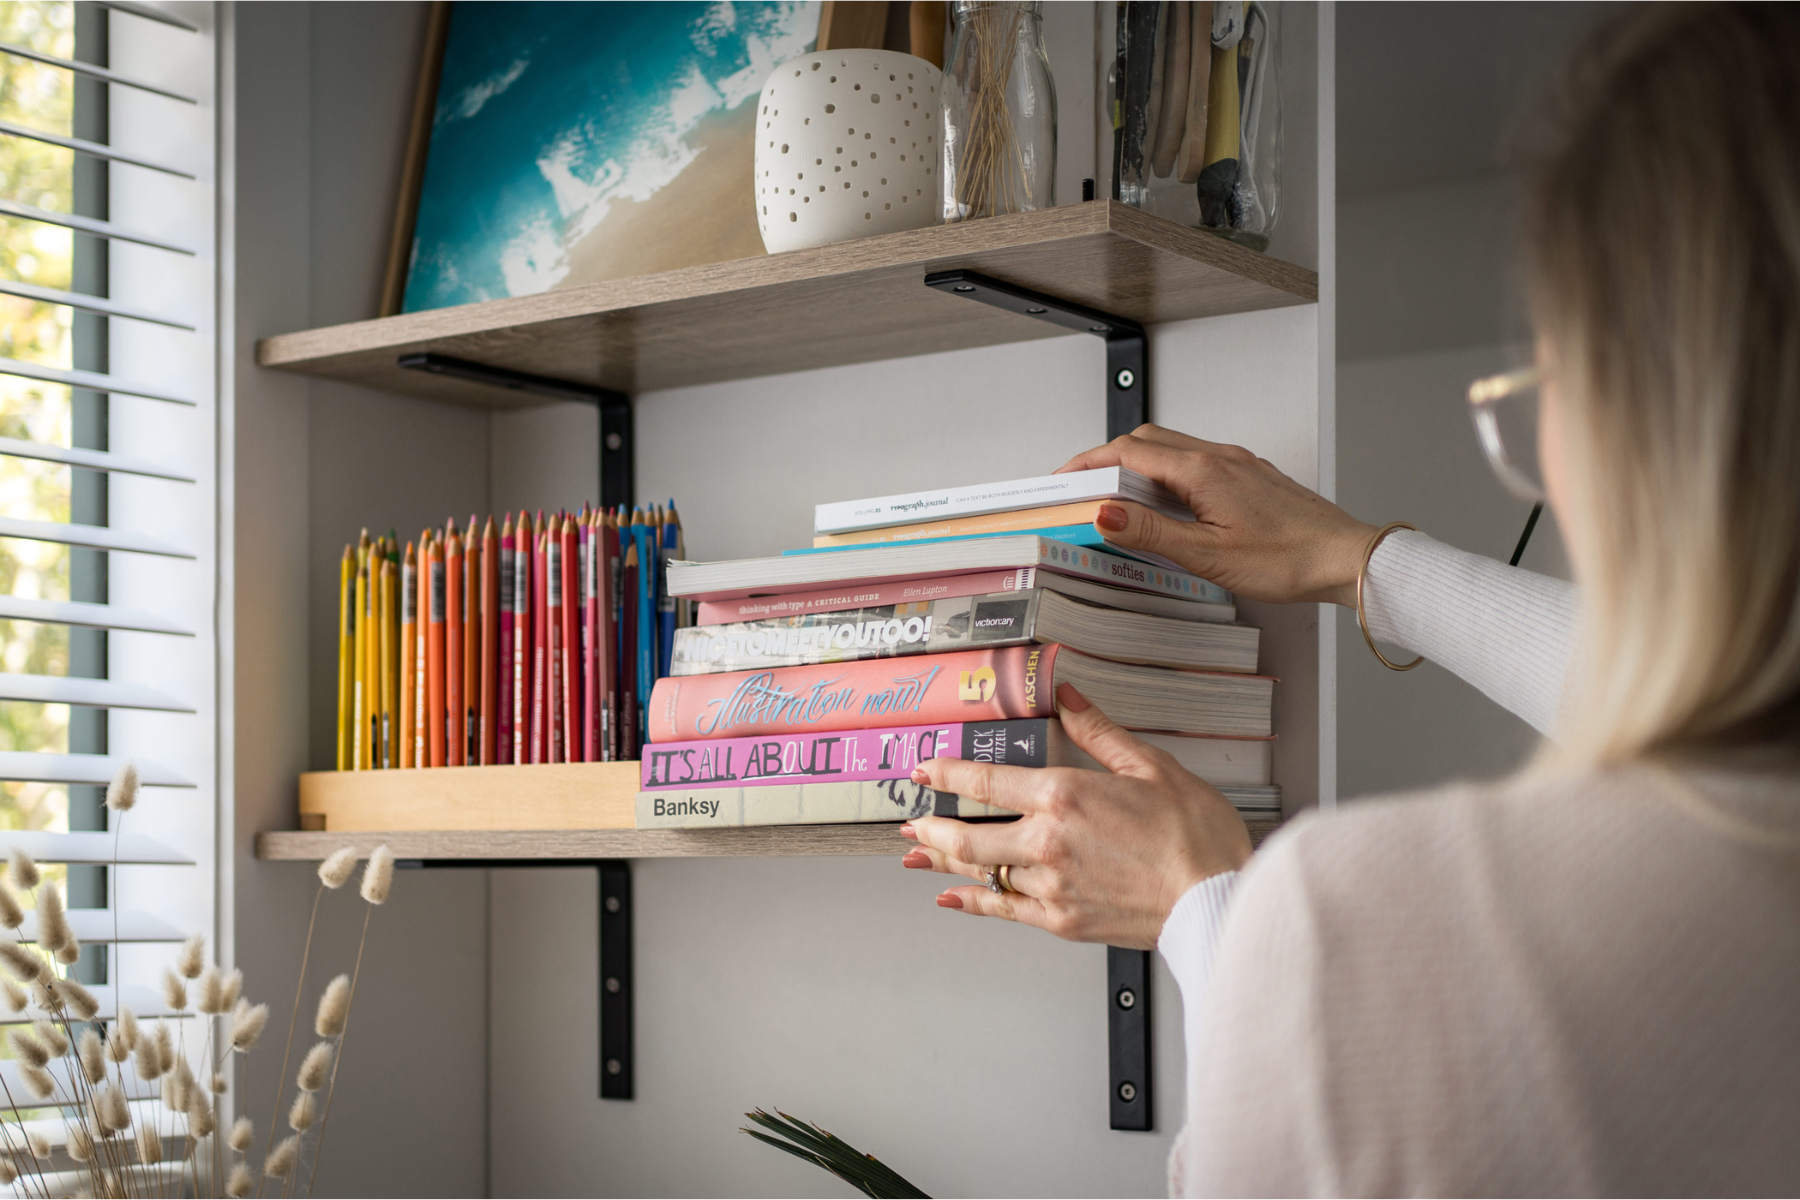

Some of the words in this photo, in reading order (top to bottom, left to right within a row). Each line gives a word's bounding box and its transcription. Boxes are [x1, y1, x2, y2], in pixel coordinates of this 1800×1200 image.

[1111, 562, 1145, 583] softies
[738, 603, 771, 615] thinking
[771, 600, 788, 611] with
[788, 599, 805, 611] type
[806, 599, 813, 607] A
[814, 596, 852, 607] CRITICAL
[853, 592, 880, 602] GUIDE
[903, 587, 921, 598] Ellen
[922, 585, 948, 597] Lupton
[958, 666, 997, 703] 5
[1025, 650, 1041, 710] TASCHEN
[695, 671, 862, 734] Illustration
[859, 664, 940, 716] now!
[741, 736, 842, 782] ABOUT
[973, 728, 994, 762] DICK
[994, 727, 1006, 764] FRIZZELL
[653, 797, 720, 818] Banksy
